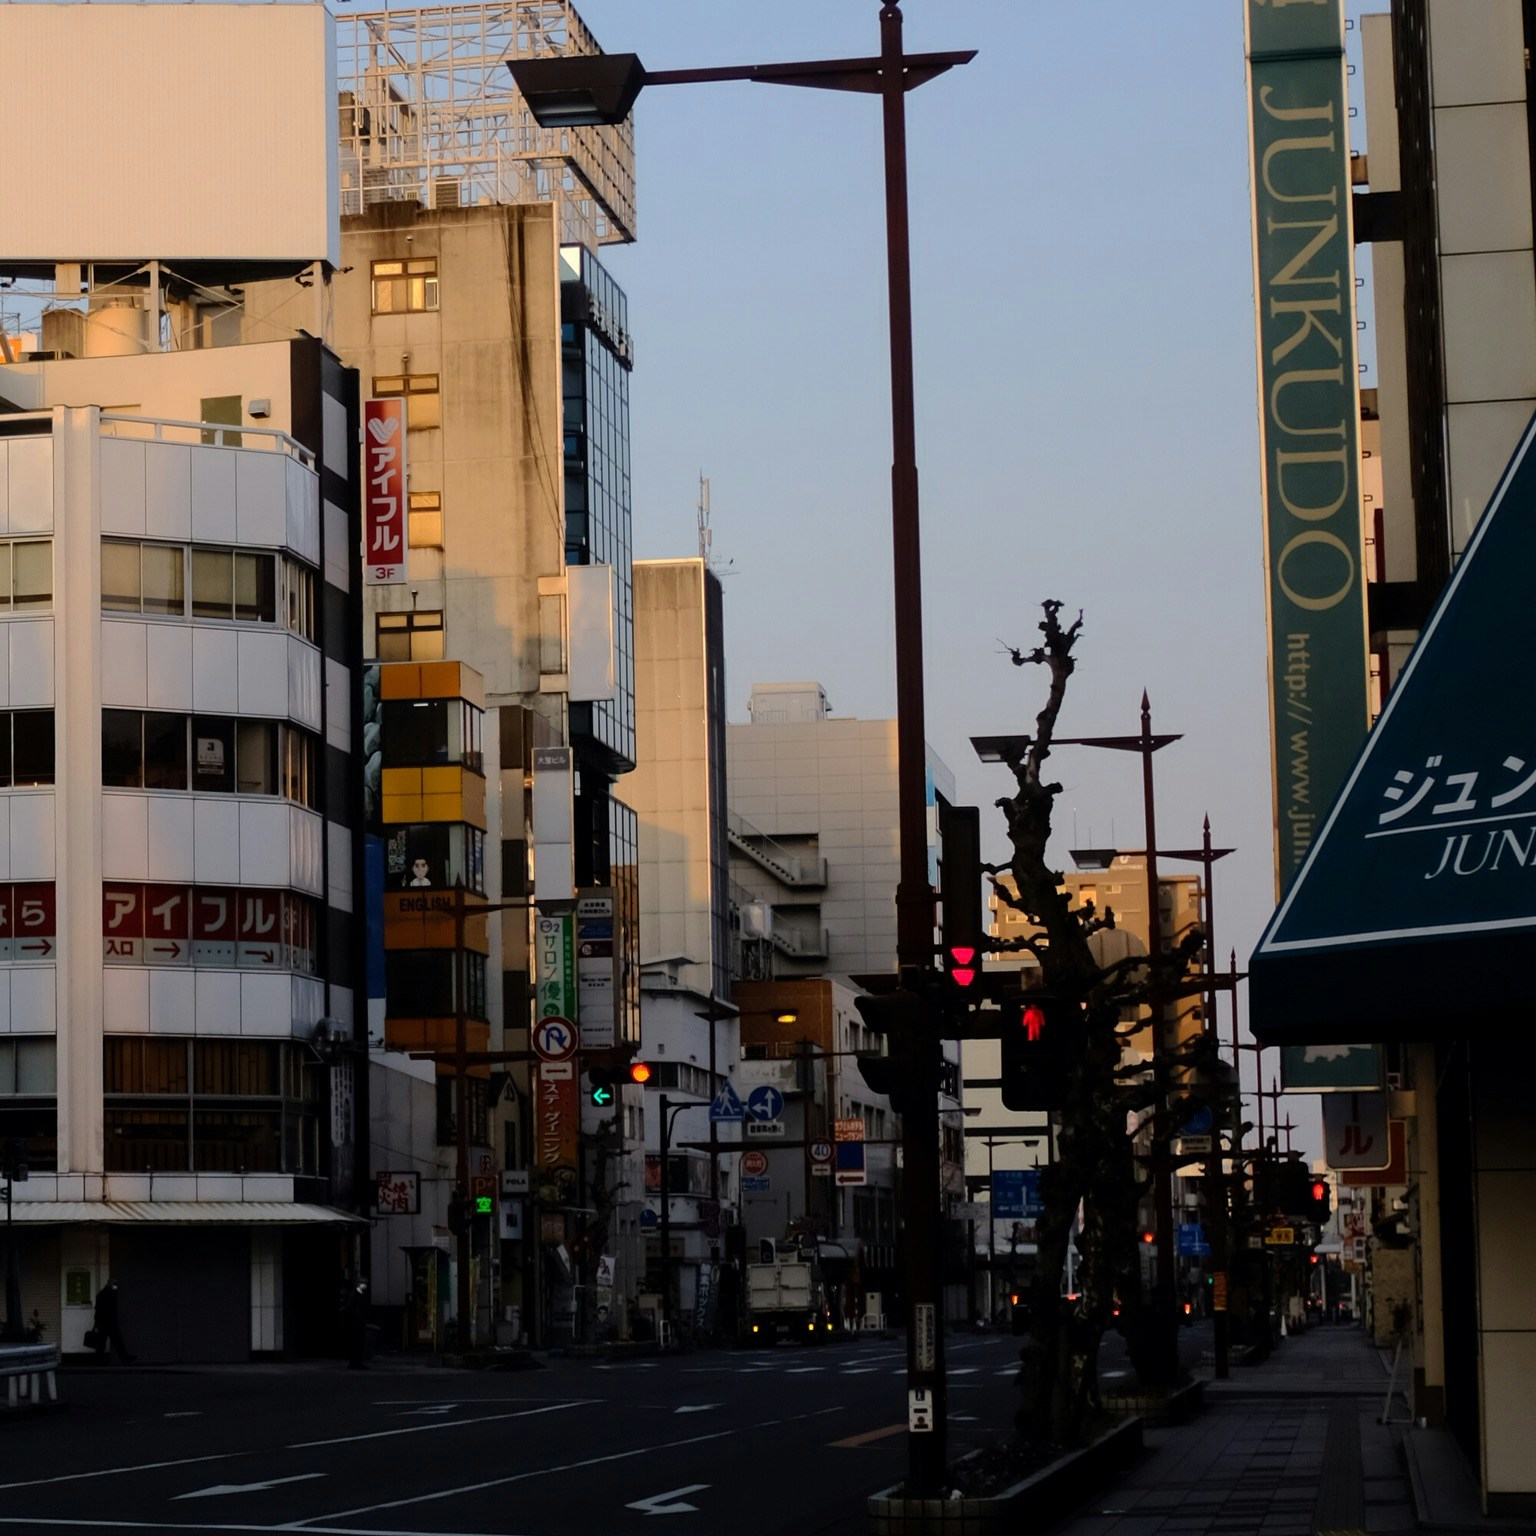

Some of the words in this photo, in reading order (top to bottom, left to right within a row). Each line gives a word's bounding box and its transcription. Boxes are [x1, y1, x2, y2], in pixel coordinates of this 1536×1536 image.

[1260, 86, 1354, 612] JUNKUDO
[371, 446, 400, 552] アイフル
[375, 567, 395, 580] 3F
[1424, 826, 1536, 880] JUN
[105, 892, 276, 934] アイフル
[399, 896, 452, 913] ENGLISH
[106, 940, 133, 956] 入口
[542, 1080, 562, 1165] ステ・ダイニング
[814, 1144, 829, 1157] 40
